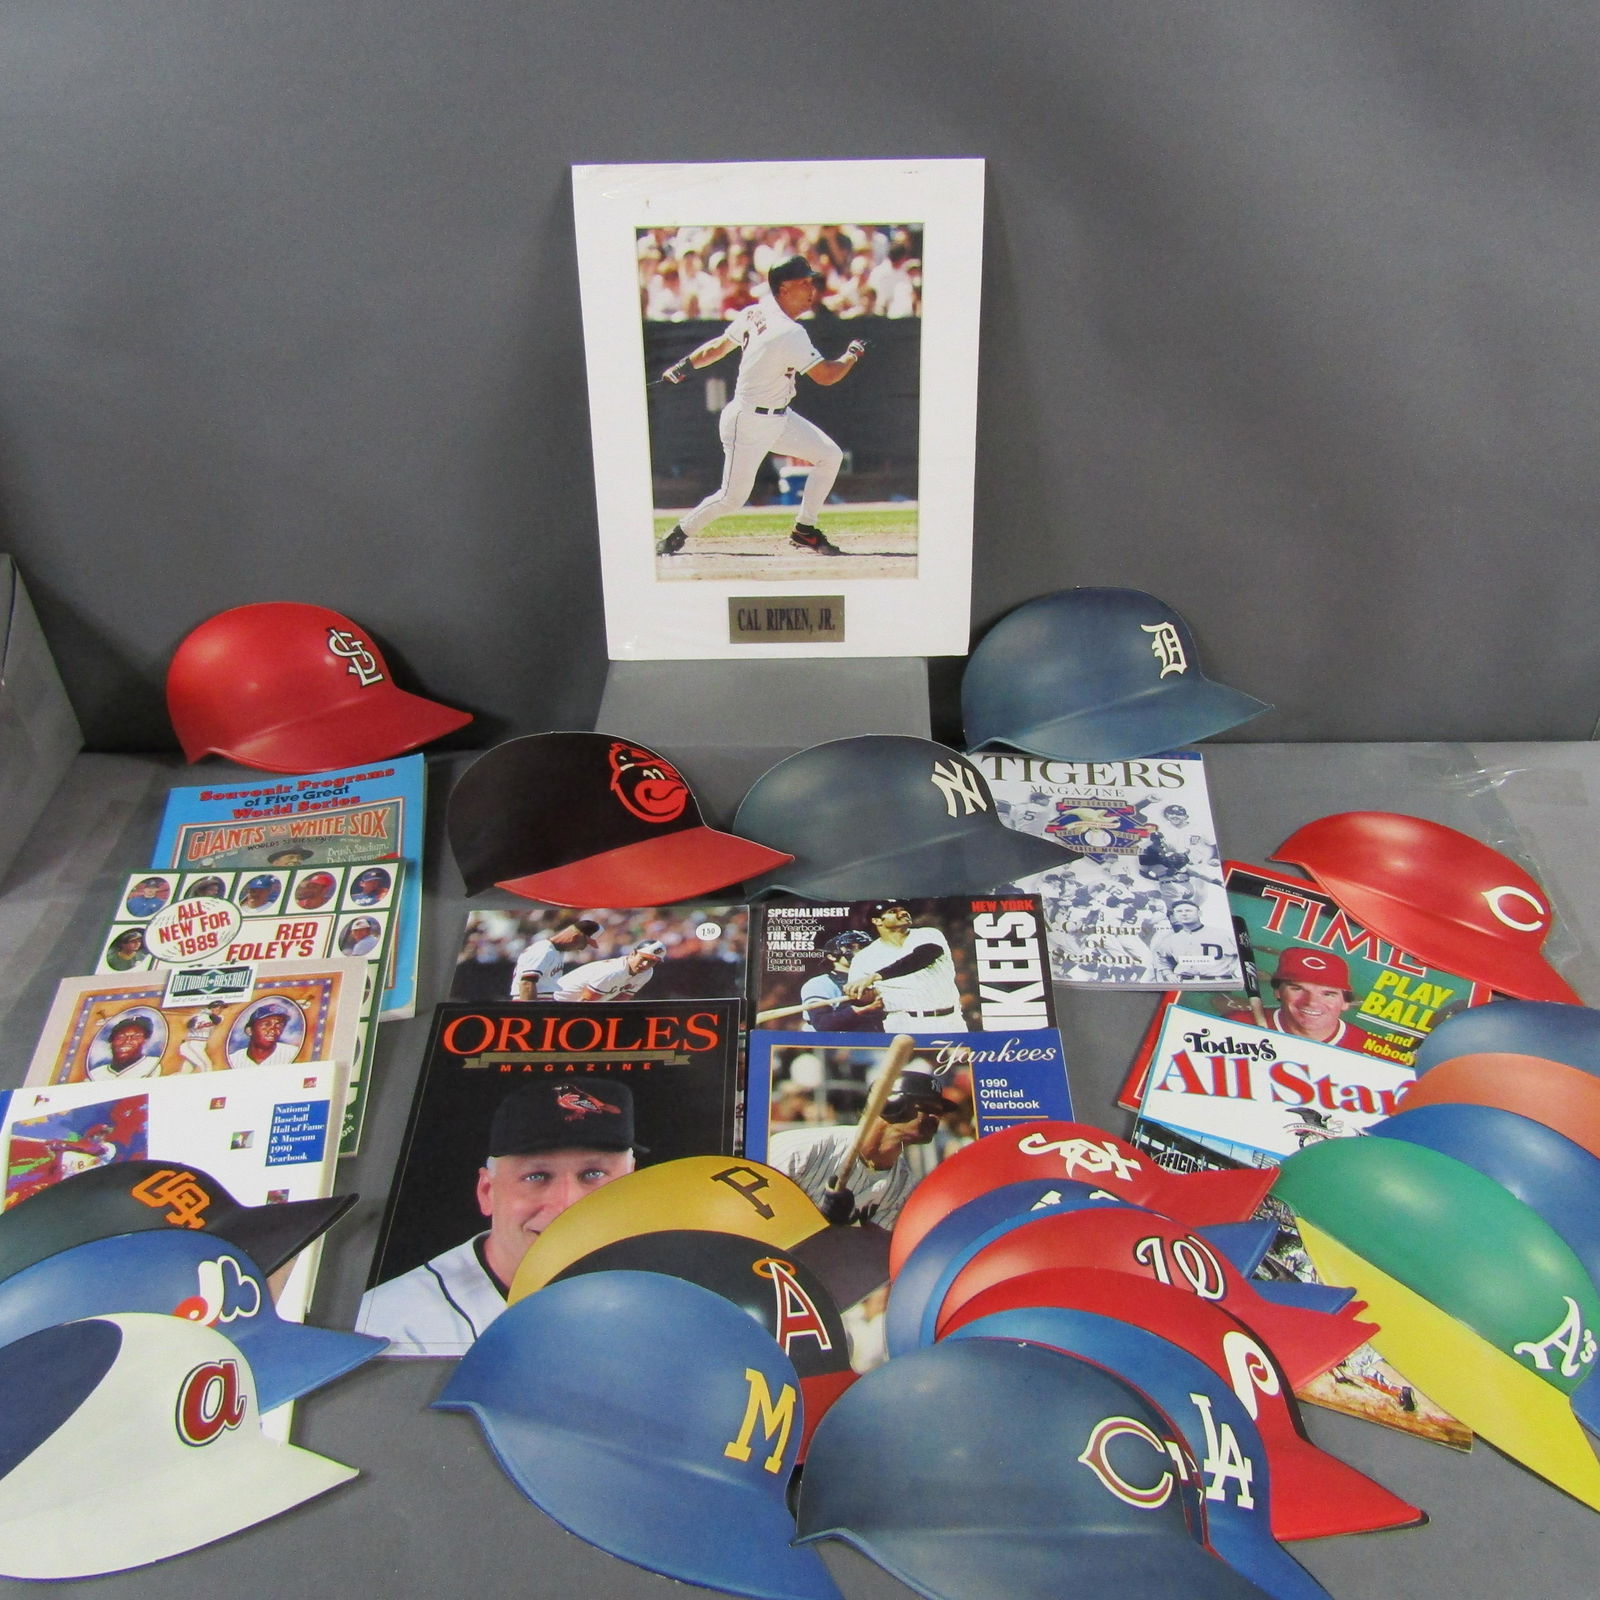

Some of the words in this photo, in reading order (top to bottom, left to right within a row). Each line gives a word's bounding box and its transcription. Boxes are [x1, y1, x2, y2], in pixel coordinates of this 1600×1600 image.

[738, 608, 761, 631] CAL
[766, 608, 813, 634] RIPKEN,
[818, 608, 836, 631] JR.
[1140, 621, 1188, 680] D
[200, 784, 293, 801] Souvenir
[297, 767, 395, 791] Programs
[981, 755, 1185, 789] TIGERS
[244, 798, 261, 807] of
[264, 792, 299, 805] Five
[302, 785, 350, 799] Great
[931, 758, 987, 818] NY
[1030, 784, 1126, 798] MAGAZINE
[233, 803, 293, 819] World
[297, 795, 361, 812] Series
[187, 826, 266, 862] GIANTS
[289, 814, 346, 839] WHITE
[349, 807, 391, 840] SOX
[178, 900, 207, 921] ALL
[768, 908, 811, 917] SPECIAL
[812, 907, 850, 917] INSERT
[971, 901, 997, 912] NEW
[1000, 900, 1034, 911] YORK
[1481, 885, 1545, 932] C
[158, 921, 193, 944] NEW
[200, 911, 231, 932] FOR
[275, 921, 319, 941] RED
[776, 917, 818, 925] Yearbook
[782, 924, 825, 932] Yearbook
[178, 932, 219, 956] 1989
[767, 931, 787, 940] THE
[790, 931, 817, 940] 1927
[767, 941, 815, 950] YANKEES
[225, 939, 315, 961] FOLEY'S
[1302, 956, 1327, 970] C
[1373, 969, 1454, 1008] PLAY
[1360, 991, 1436, 1032] BALL
[442, 1012, 721, 1055] ORIOLES
[930, 1038, 1057, 1077] Yankees
[1363, 1038, 1416, 1066] Nobody
[500, 1062, 652, 1073] MAGAZINE
[1154, 1048, 1257, 1101] All
[980, 1079, 1008, 1087] 1990
[980, 1089, 1024, 1098] Official
[277, 1104, 310, 1114] National
[981, 1100, 1040, 1109] Yearbook
[273, 1125, 291, 1133] Hall
[291, 1124, 301, 1132] of
[302, 1123, 325, 1131] Fame
[275, 1114, 309, 1123] Baseball
[271, 1136, 279, 1144] &
[271, 1145, 293, 1153] 1990
[269, 1152, 308, 1163] Yearbook
[130, 1169, 210, 1230] SF
[710, 1165, 775, 1221] P
[774, 1258, 832, 1356] A
[1513, 1295, 1597, 1378] A's
[1222, 1331, 1280, 1421] P
[724, 1367, 798, 1474] M
[1077, 1415, 1174, 1509] C
[1189, 1392, 1255, 1510] LA
